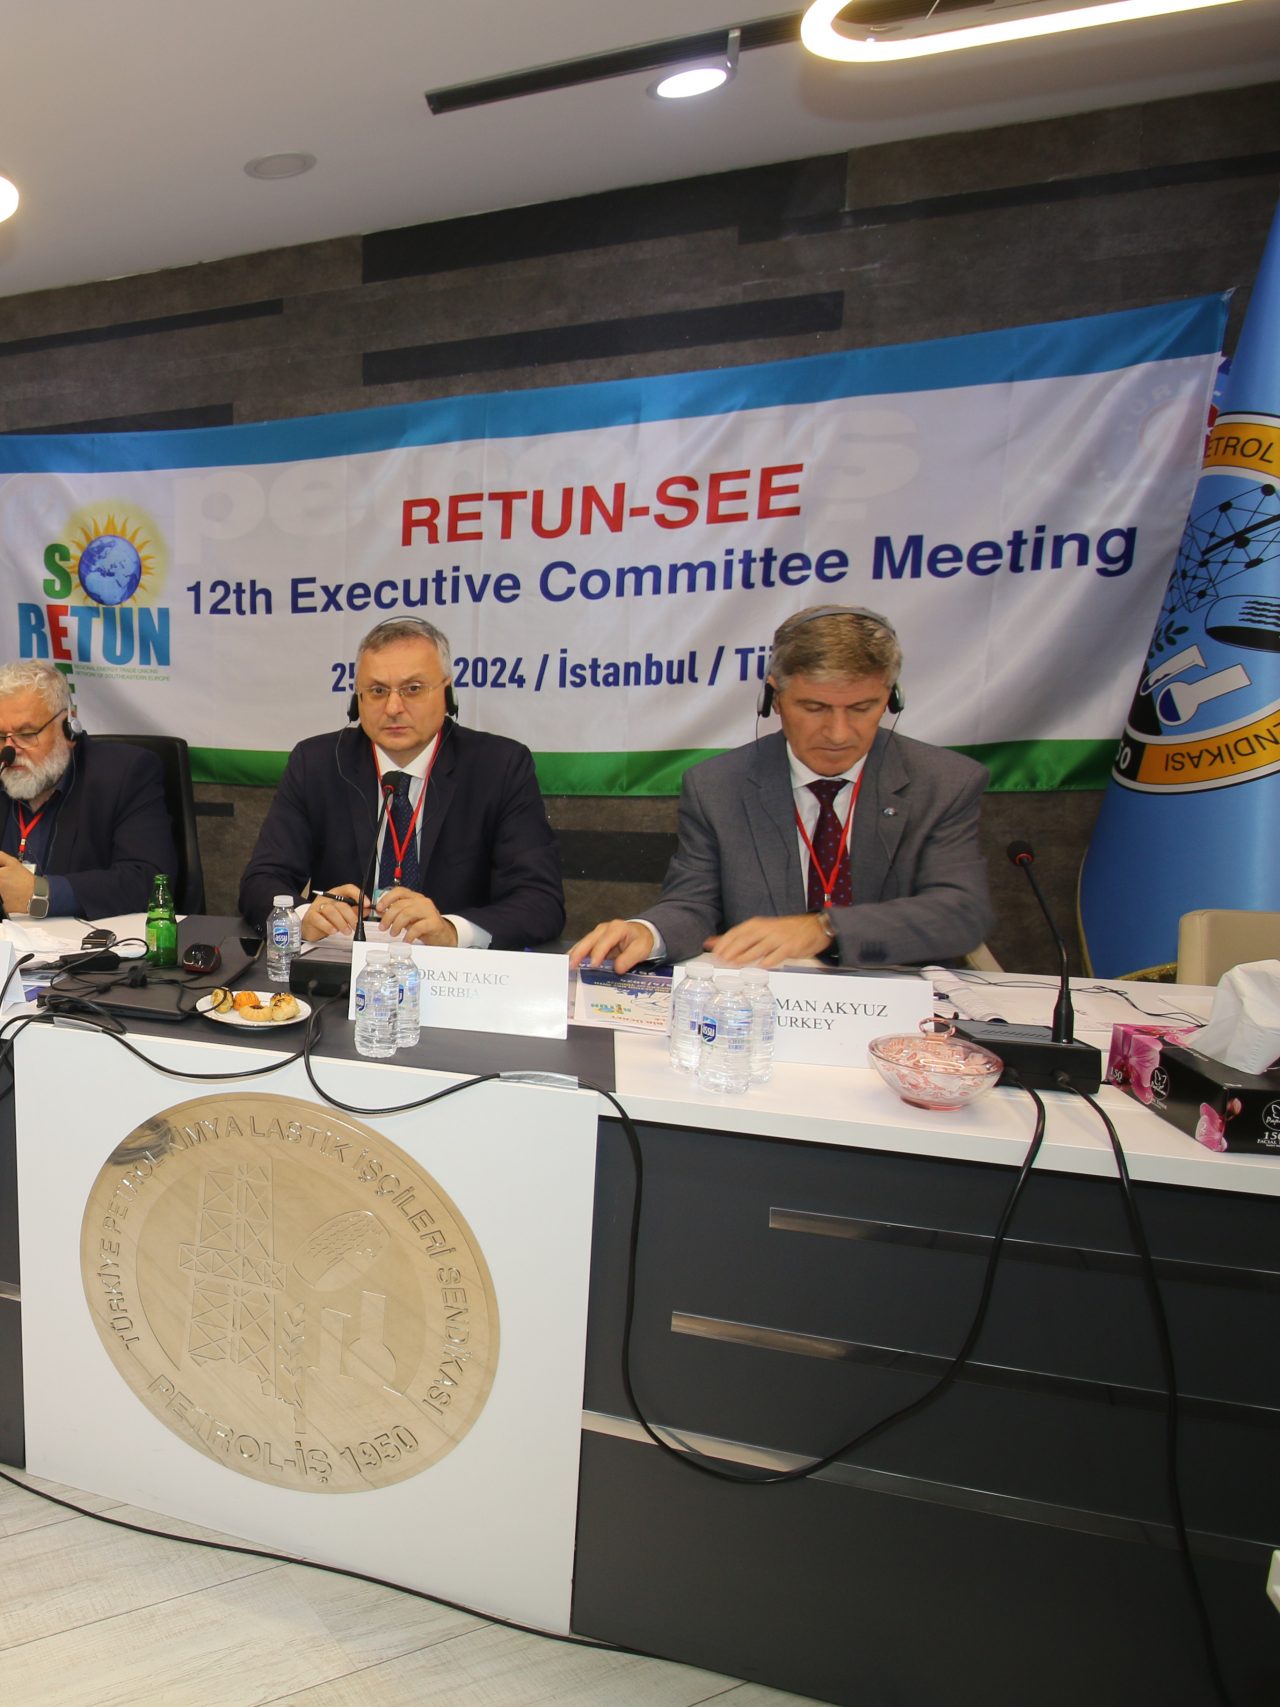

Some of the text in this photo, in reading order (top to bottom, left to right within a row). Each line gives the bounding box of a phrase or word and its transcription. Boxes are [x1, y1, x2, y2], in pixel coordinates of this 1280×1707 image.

[401, 463, 804, 547] RETUN-SEE
[186, 524, 1138, 616] 12th Executive Committee Meeting
[17, 603, 171, 667] RETUN
[453, 656, 526, 689] 2024
[558, 648, 699, 689] İstanbul
[417, 968, 510, 986] ORAN TAKIC
[776, 998, 888, 1018] MAN AKYUZ
[777, 1015, 836, 1031] URKEY
[339, 1425, 419, 1474] 1950
